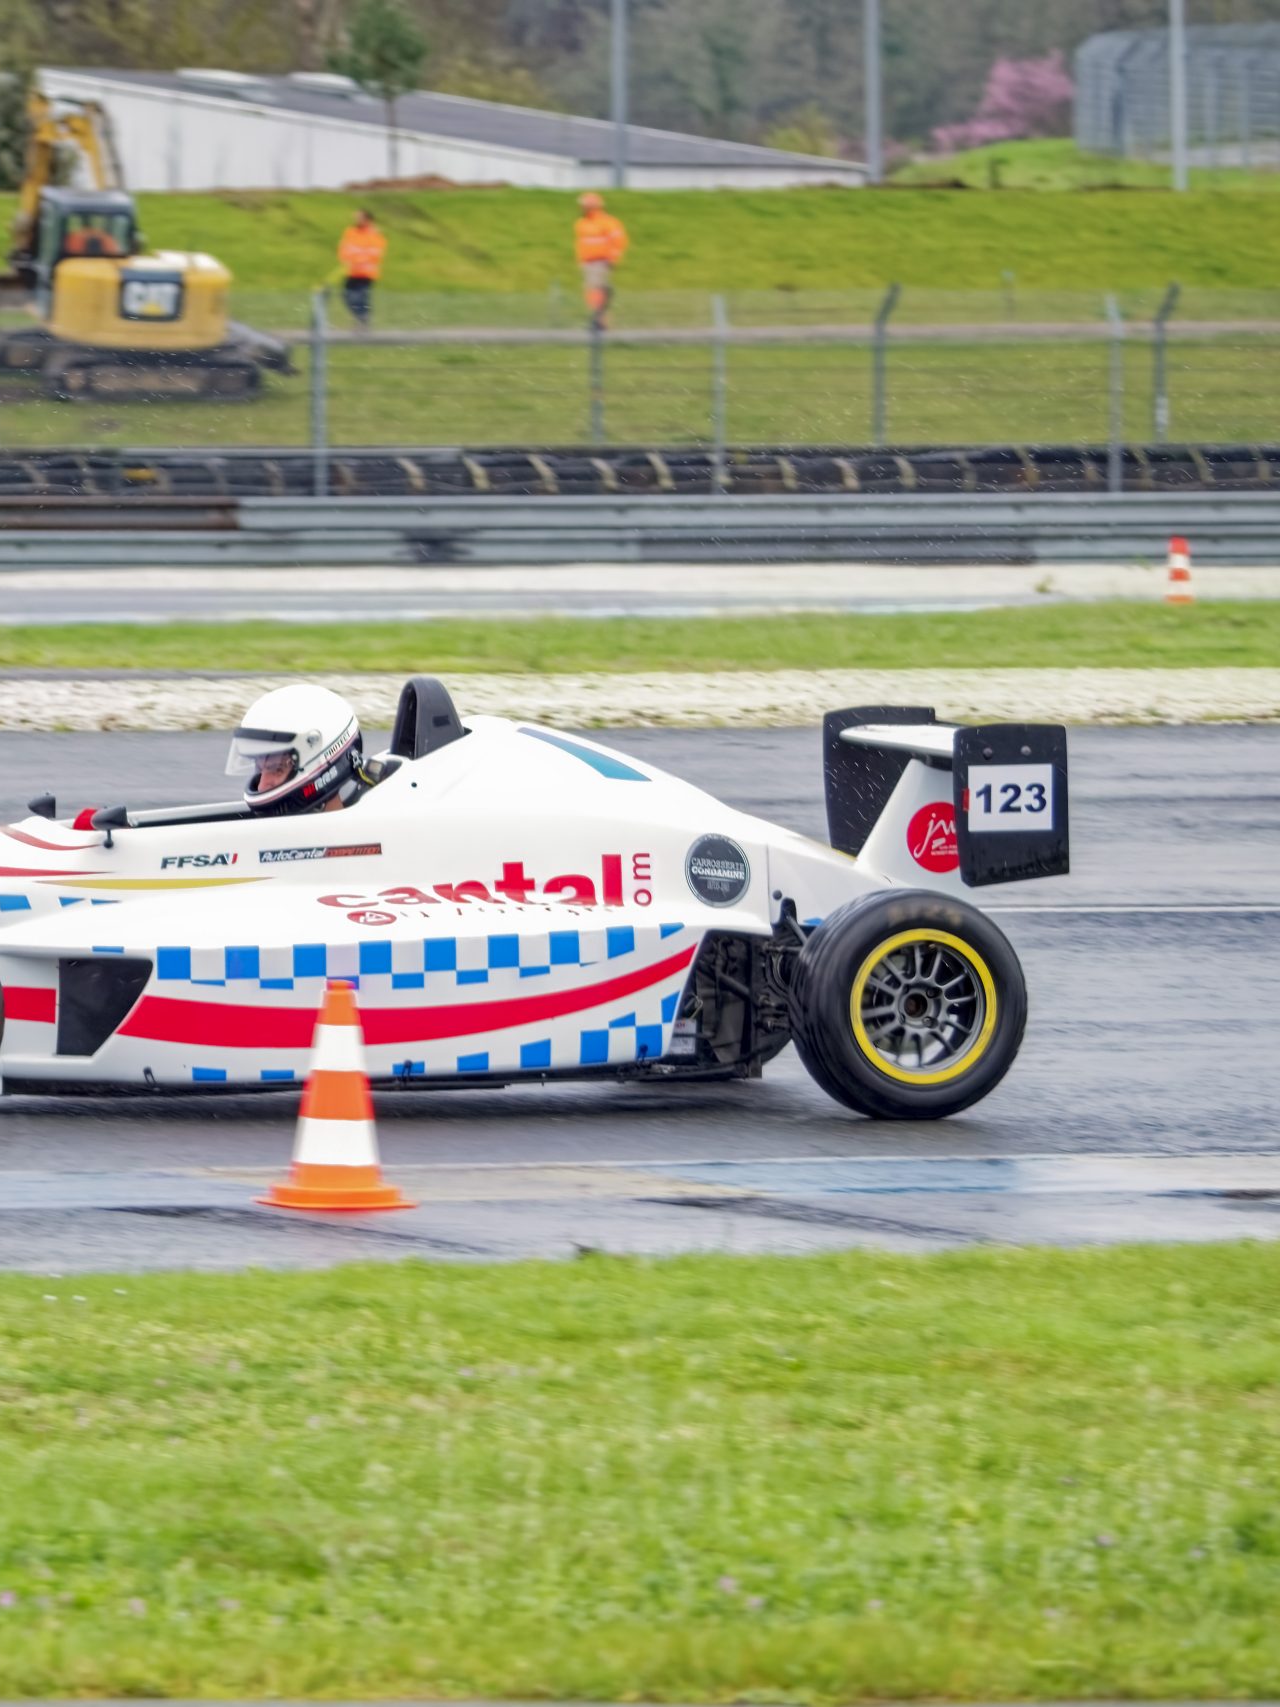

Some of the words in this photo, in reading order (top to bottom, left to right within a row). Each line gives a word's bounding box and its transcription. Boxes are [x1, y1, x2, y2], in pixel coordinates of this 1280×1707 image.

[975, 783, 1047, 813] 123
[160, 853, 230, 869] FFSA
[691, 857, 745, 871] CARROSSERIE
[316, 854, 624, 908] cantal
[691, 866, 745, 880] CONDAMINE
